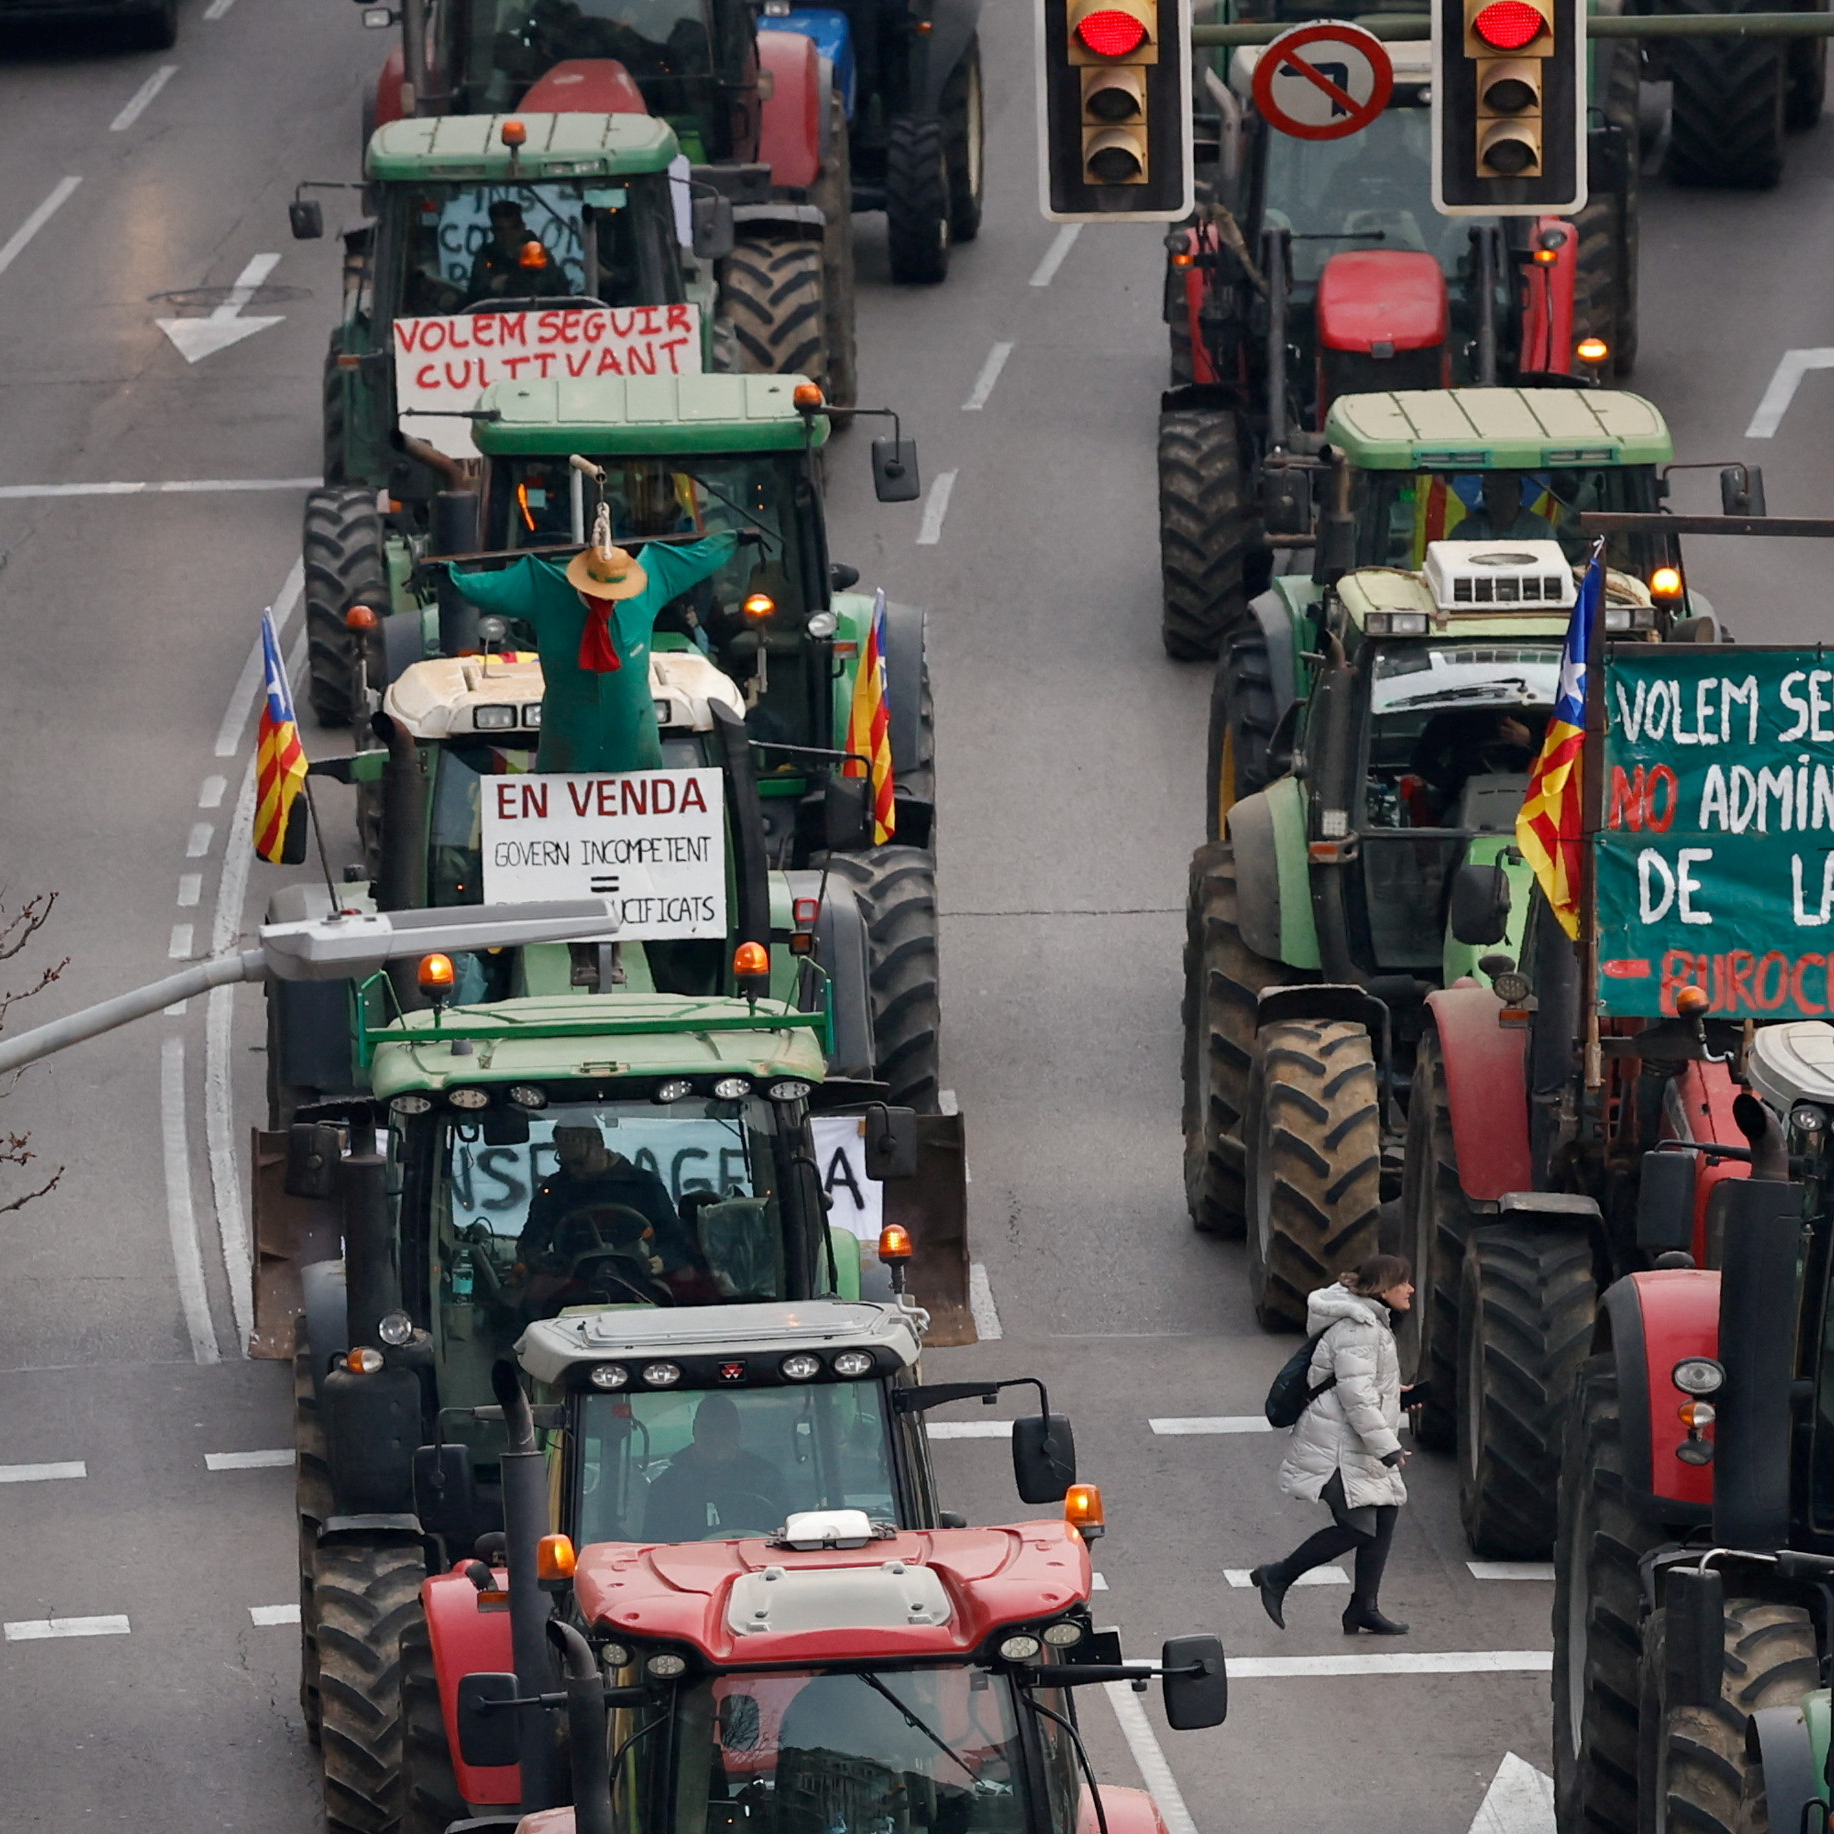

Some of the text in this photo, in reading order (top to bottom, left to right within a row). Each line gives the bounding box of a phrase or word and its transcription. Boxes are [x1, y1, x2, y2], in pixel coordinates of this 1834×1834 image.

[393, 303, 692, 353] VOLEM SEGUIR
[1614, 674, 1759, 745] VOLEM
[496, 778, 708, 819] EN VENDA
[1608, 763, 1679, 833] NO
[494, 836, 712, 867] GOVERN INCOMPETENT
[611, 896, 716, 925] UCIFICATS
[1637, 847, 1713, 925] DE
